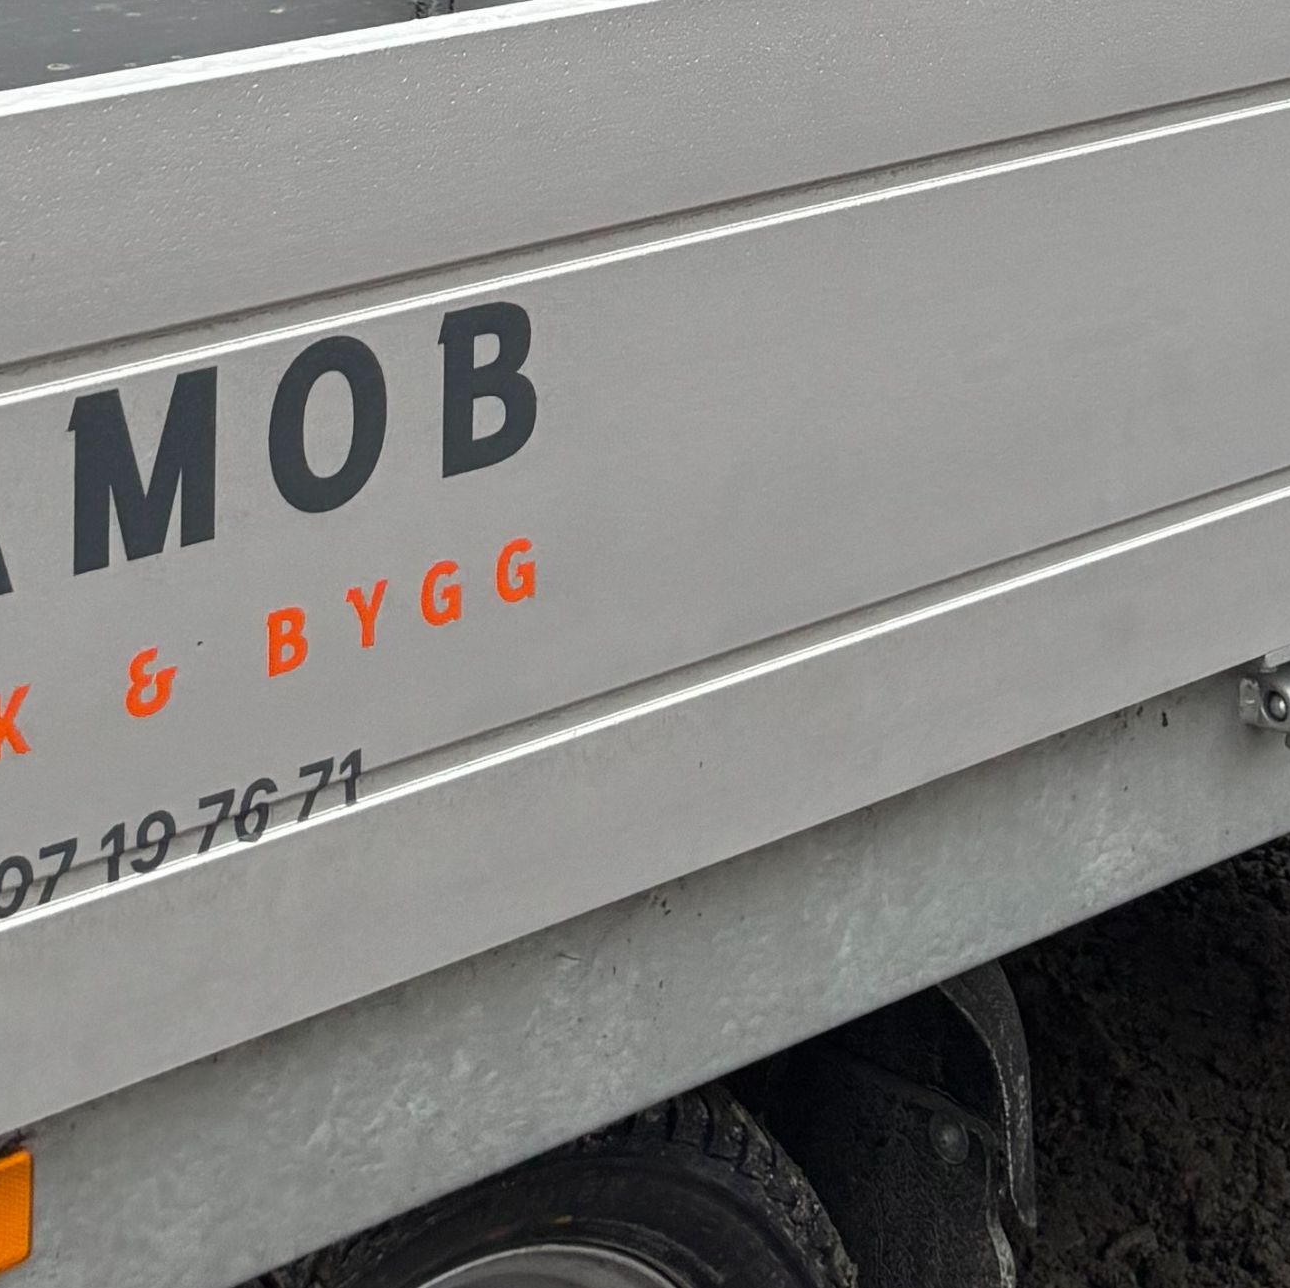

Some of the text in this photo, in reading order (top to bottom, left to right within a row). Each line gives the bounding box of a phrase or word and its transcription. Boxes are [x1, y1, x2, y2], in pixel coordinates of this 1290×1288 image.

[124, 646, 177, 717] &
[266, 537, 537, 677] BYGG
[100, 809, 177, 883] 19
[197, 777, 278, 854] 76
[297, 748, 363, 822] 71
